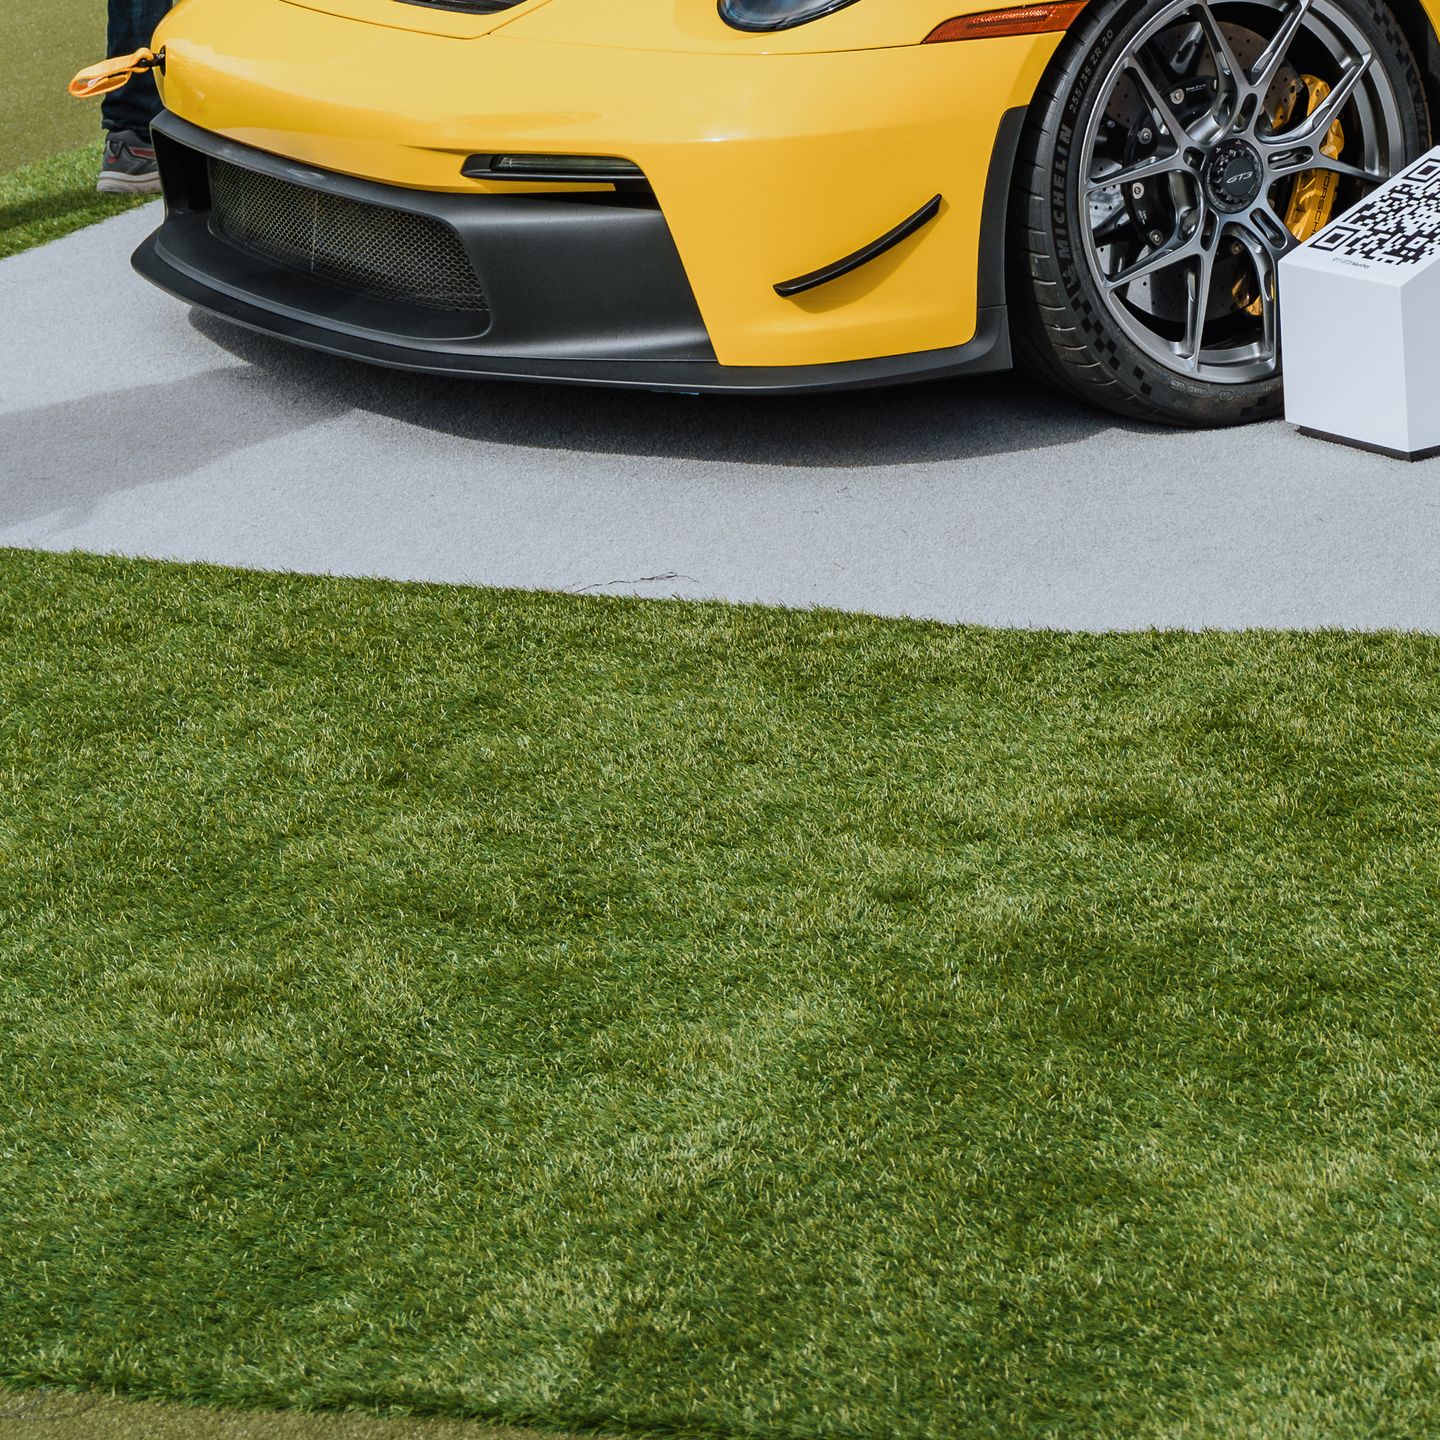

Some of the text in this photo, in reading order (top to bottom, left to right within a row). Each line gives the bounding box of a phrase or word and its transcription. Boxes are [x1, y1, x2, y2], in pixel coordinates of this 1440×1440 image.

[1053, 123, 1073, 260] MICHELIN
[1226, 170, 1254, 184] GT3
[1311, 169, 1332, 235] ORSCH
